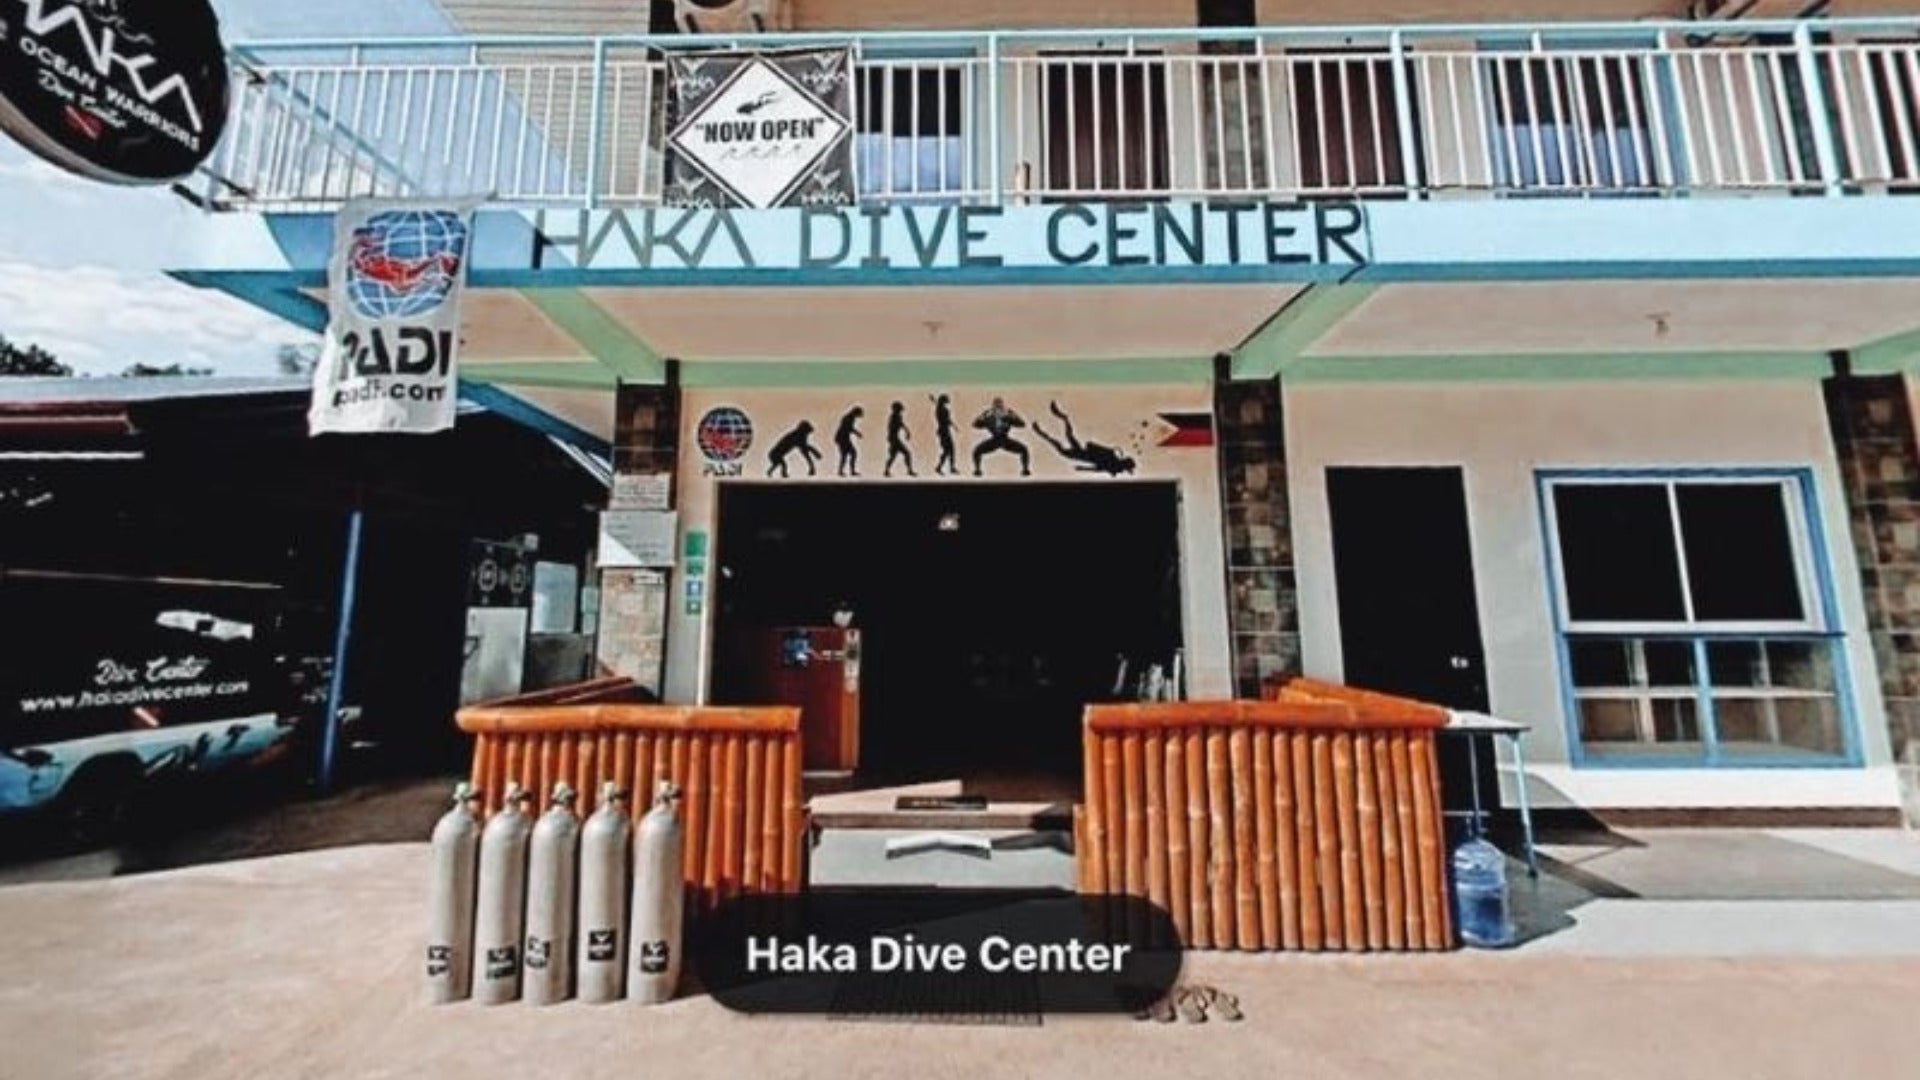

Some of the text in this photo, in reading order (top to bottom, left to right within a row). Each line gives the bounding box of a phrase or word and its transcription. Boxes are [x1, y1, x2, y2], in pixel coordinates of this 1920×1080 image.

[20, 37, 200, 152] OCEAN WARRIORS
[696, 117, 825, 143] "NOW OPEN"
[531, 202, 1366, 269] HAKA DIVE CENTER
[340, 326, 453, 380] PADI
